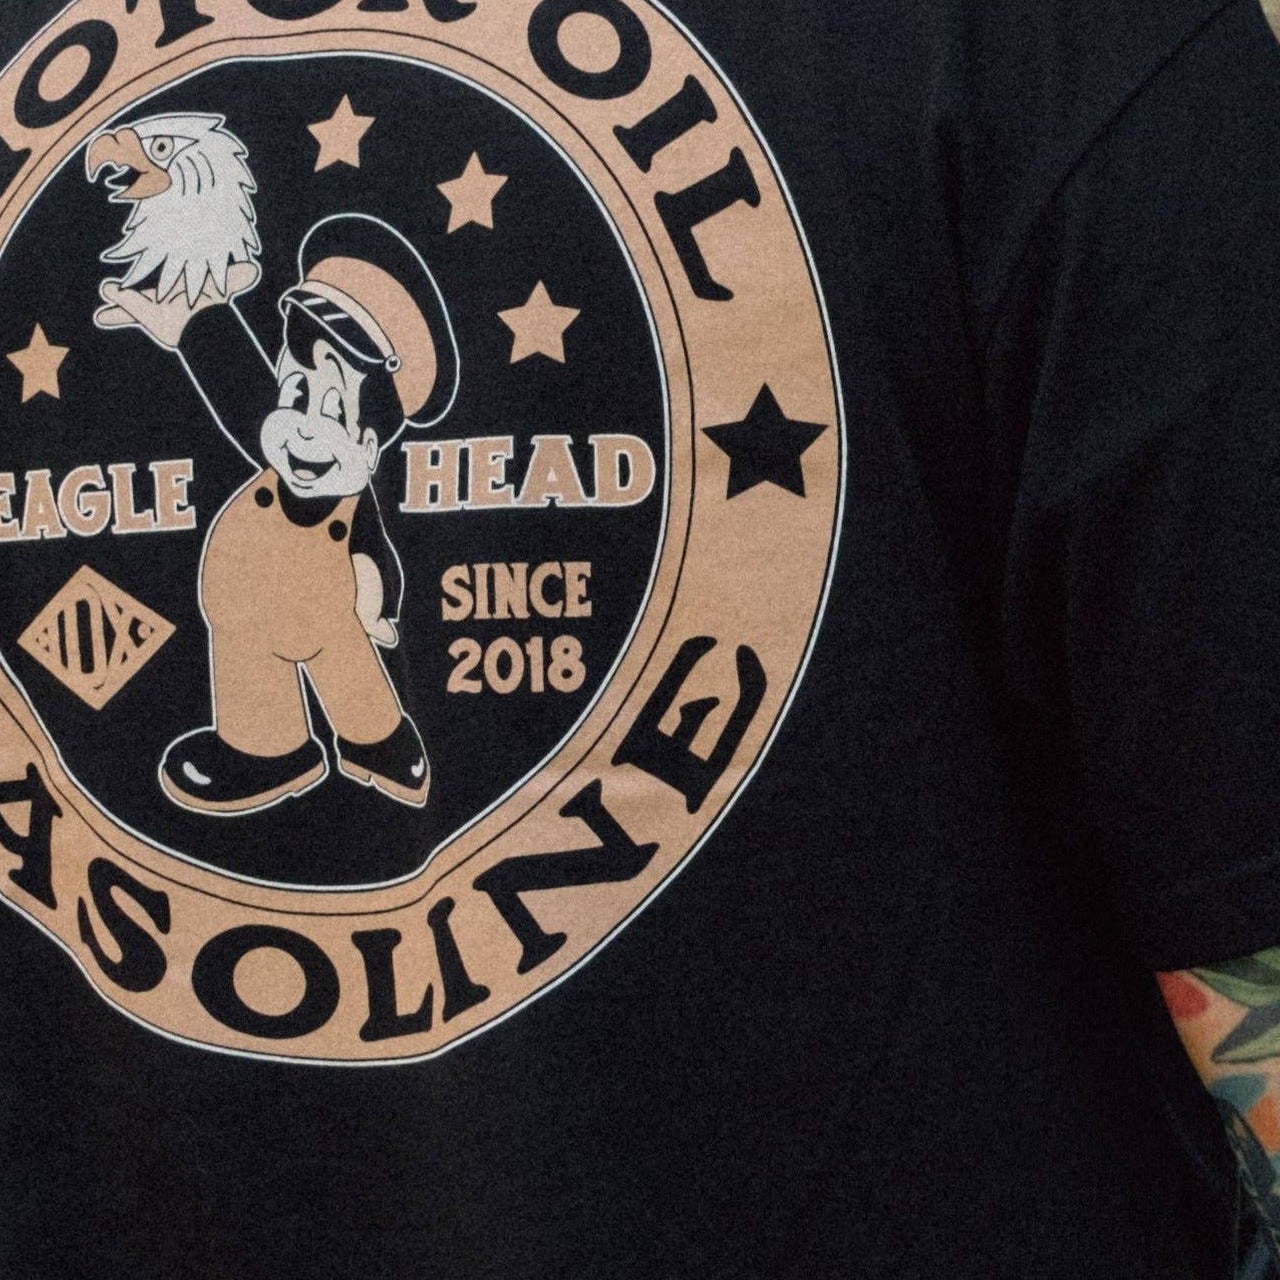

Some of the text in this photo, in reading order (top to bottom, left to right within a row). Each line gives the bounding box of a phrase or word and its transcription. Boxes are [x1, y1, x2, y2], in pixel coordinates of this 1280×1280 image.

[399, 433, 657, 514] HEAD
[441, 560, 593, 622] SINCE
[446, 634, 587, 695] 2018
